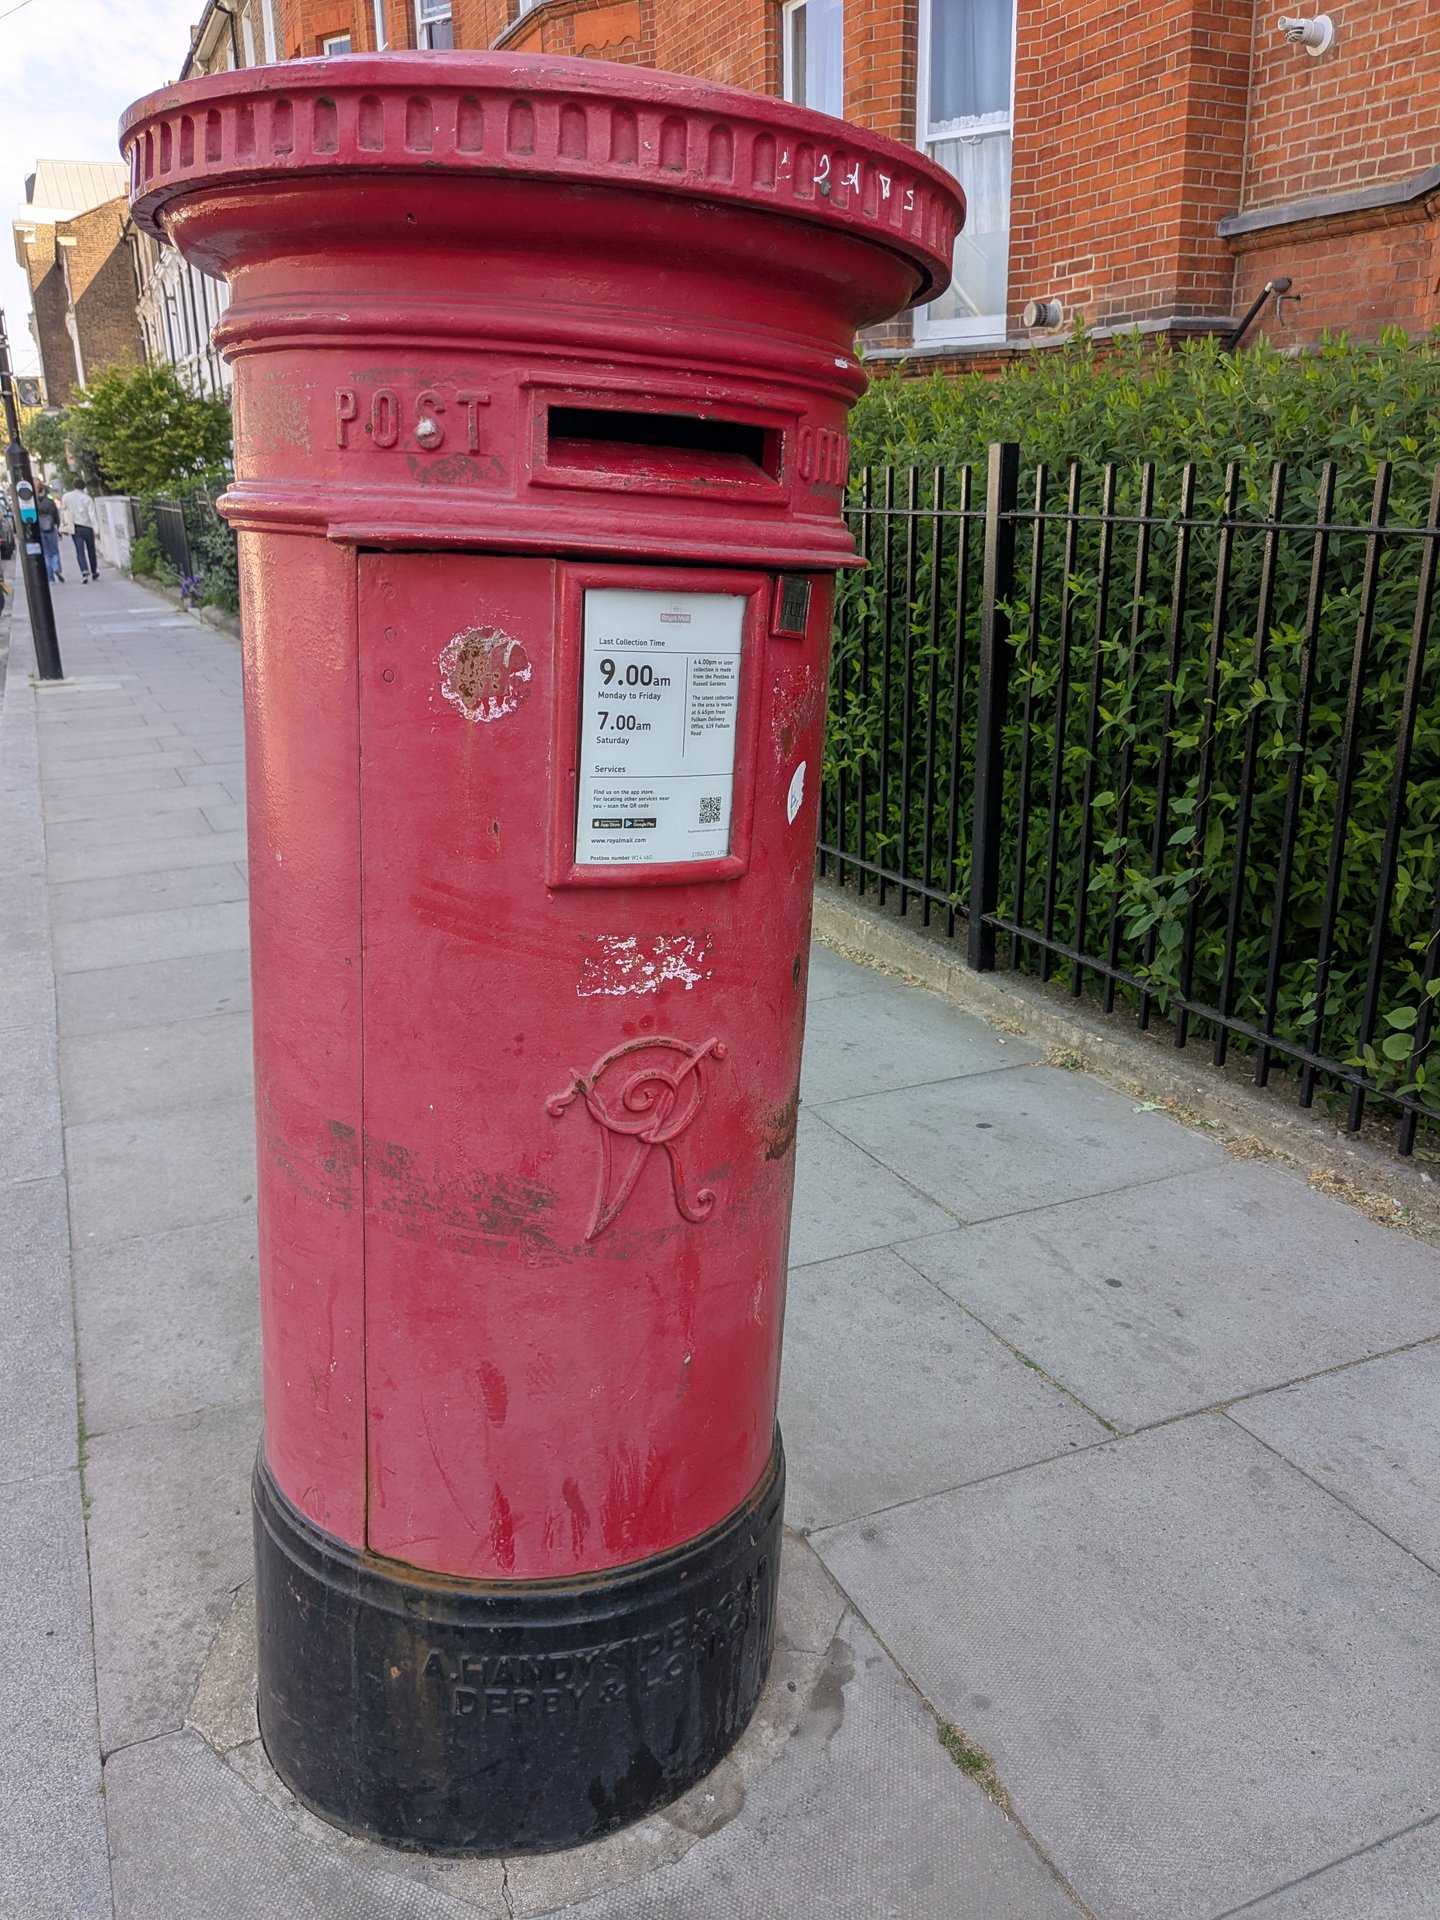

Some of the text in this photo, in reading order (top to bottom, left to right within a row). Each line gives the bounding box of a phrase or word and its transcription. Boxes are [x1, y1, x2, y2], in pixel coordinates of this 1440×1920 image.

[334, 386, 491, 454] POST
[616, 638, 648, 646] Collection
[649, 639, 666, 647] Time
[600, 658, 671, 687] 9.00am
[598, 691, 627, 700] Monday
[639, 692, 661, 701] Friday
[597, 711, 651, 731] 7.00am
[596, 736, 630, 745] Saturday
[594, 765, 626, 773] Services
[455, 1681, 591, 1717] DERBY
